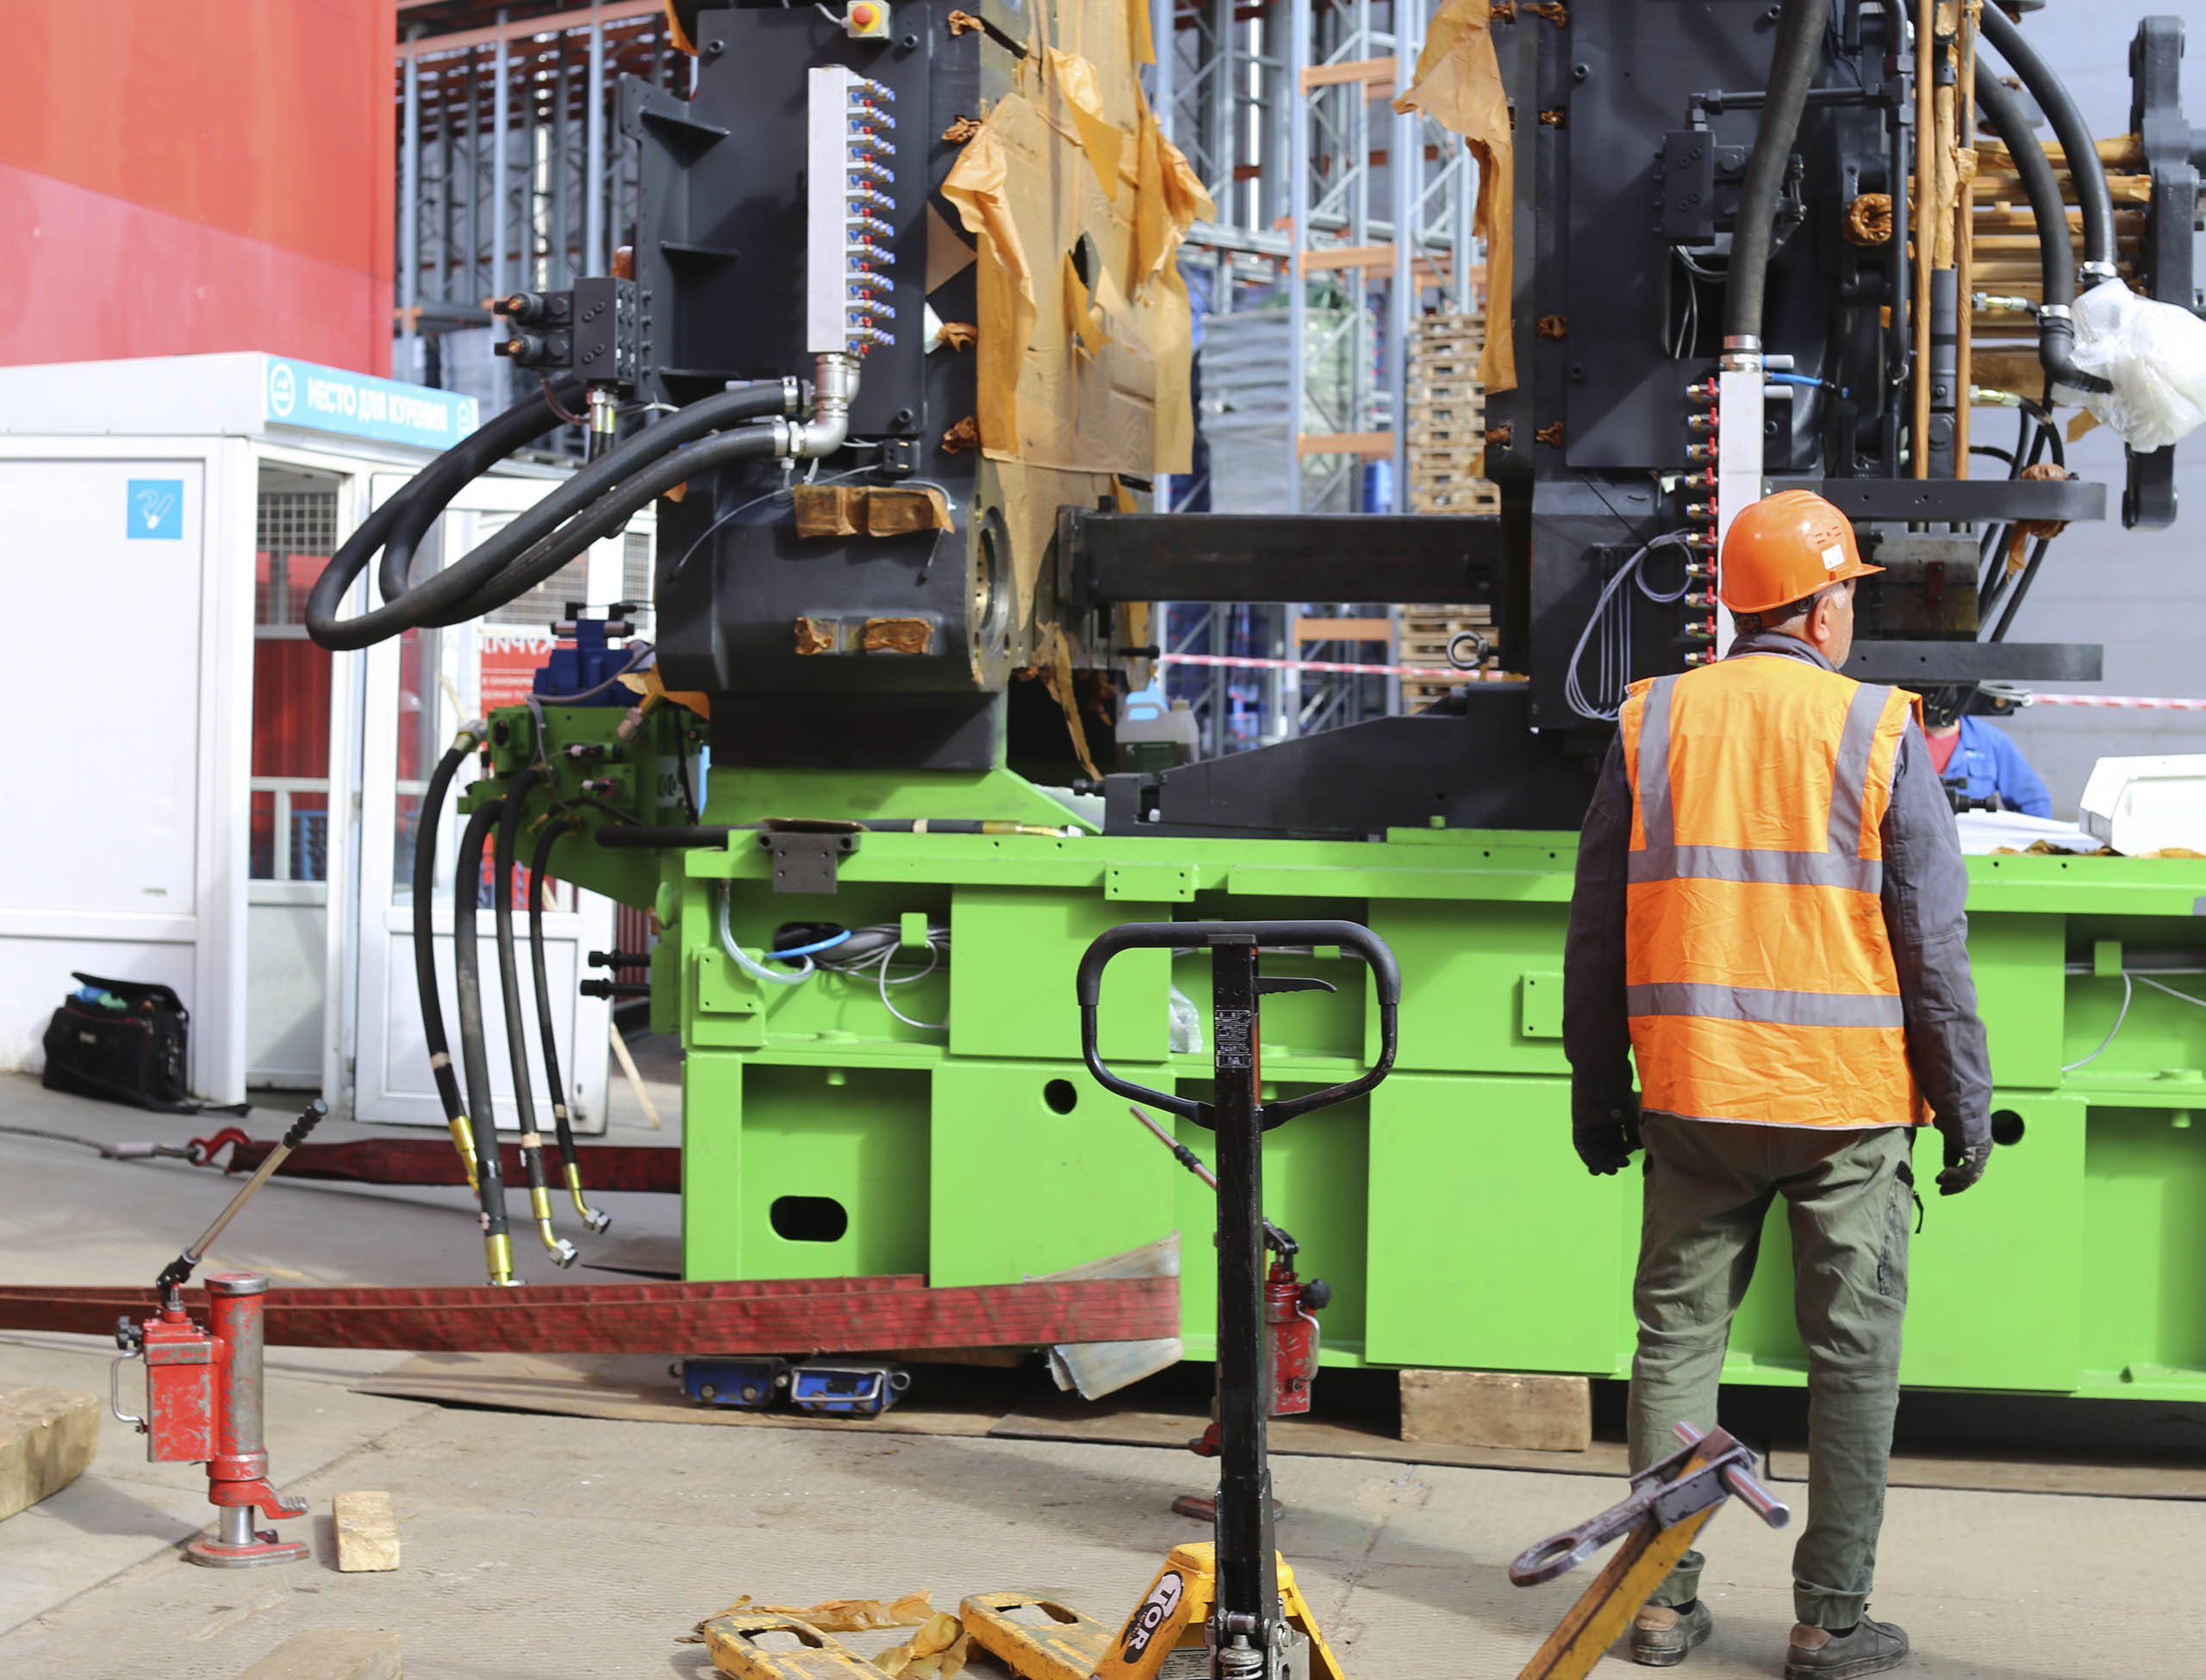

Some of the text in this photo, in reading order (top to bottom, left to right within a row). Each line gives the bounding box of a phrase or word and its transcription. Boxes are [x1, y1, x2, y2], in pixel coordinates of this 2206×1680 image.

[308, 376, 449, 432] МЕСТО ДЛЯ КУРЕНИЯ
[1129, 1588, 1176, 1650] TOR
